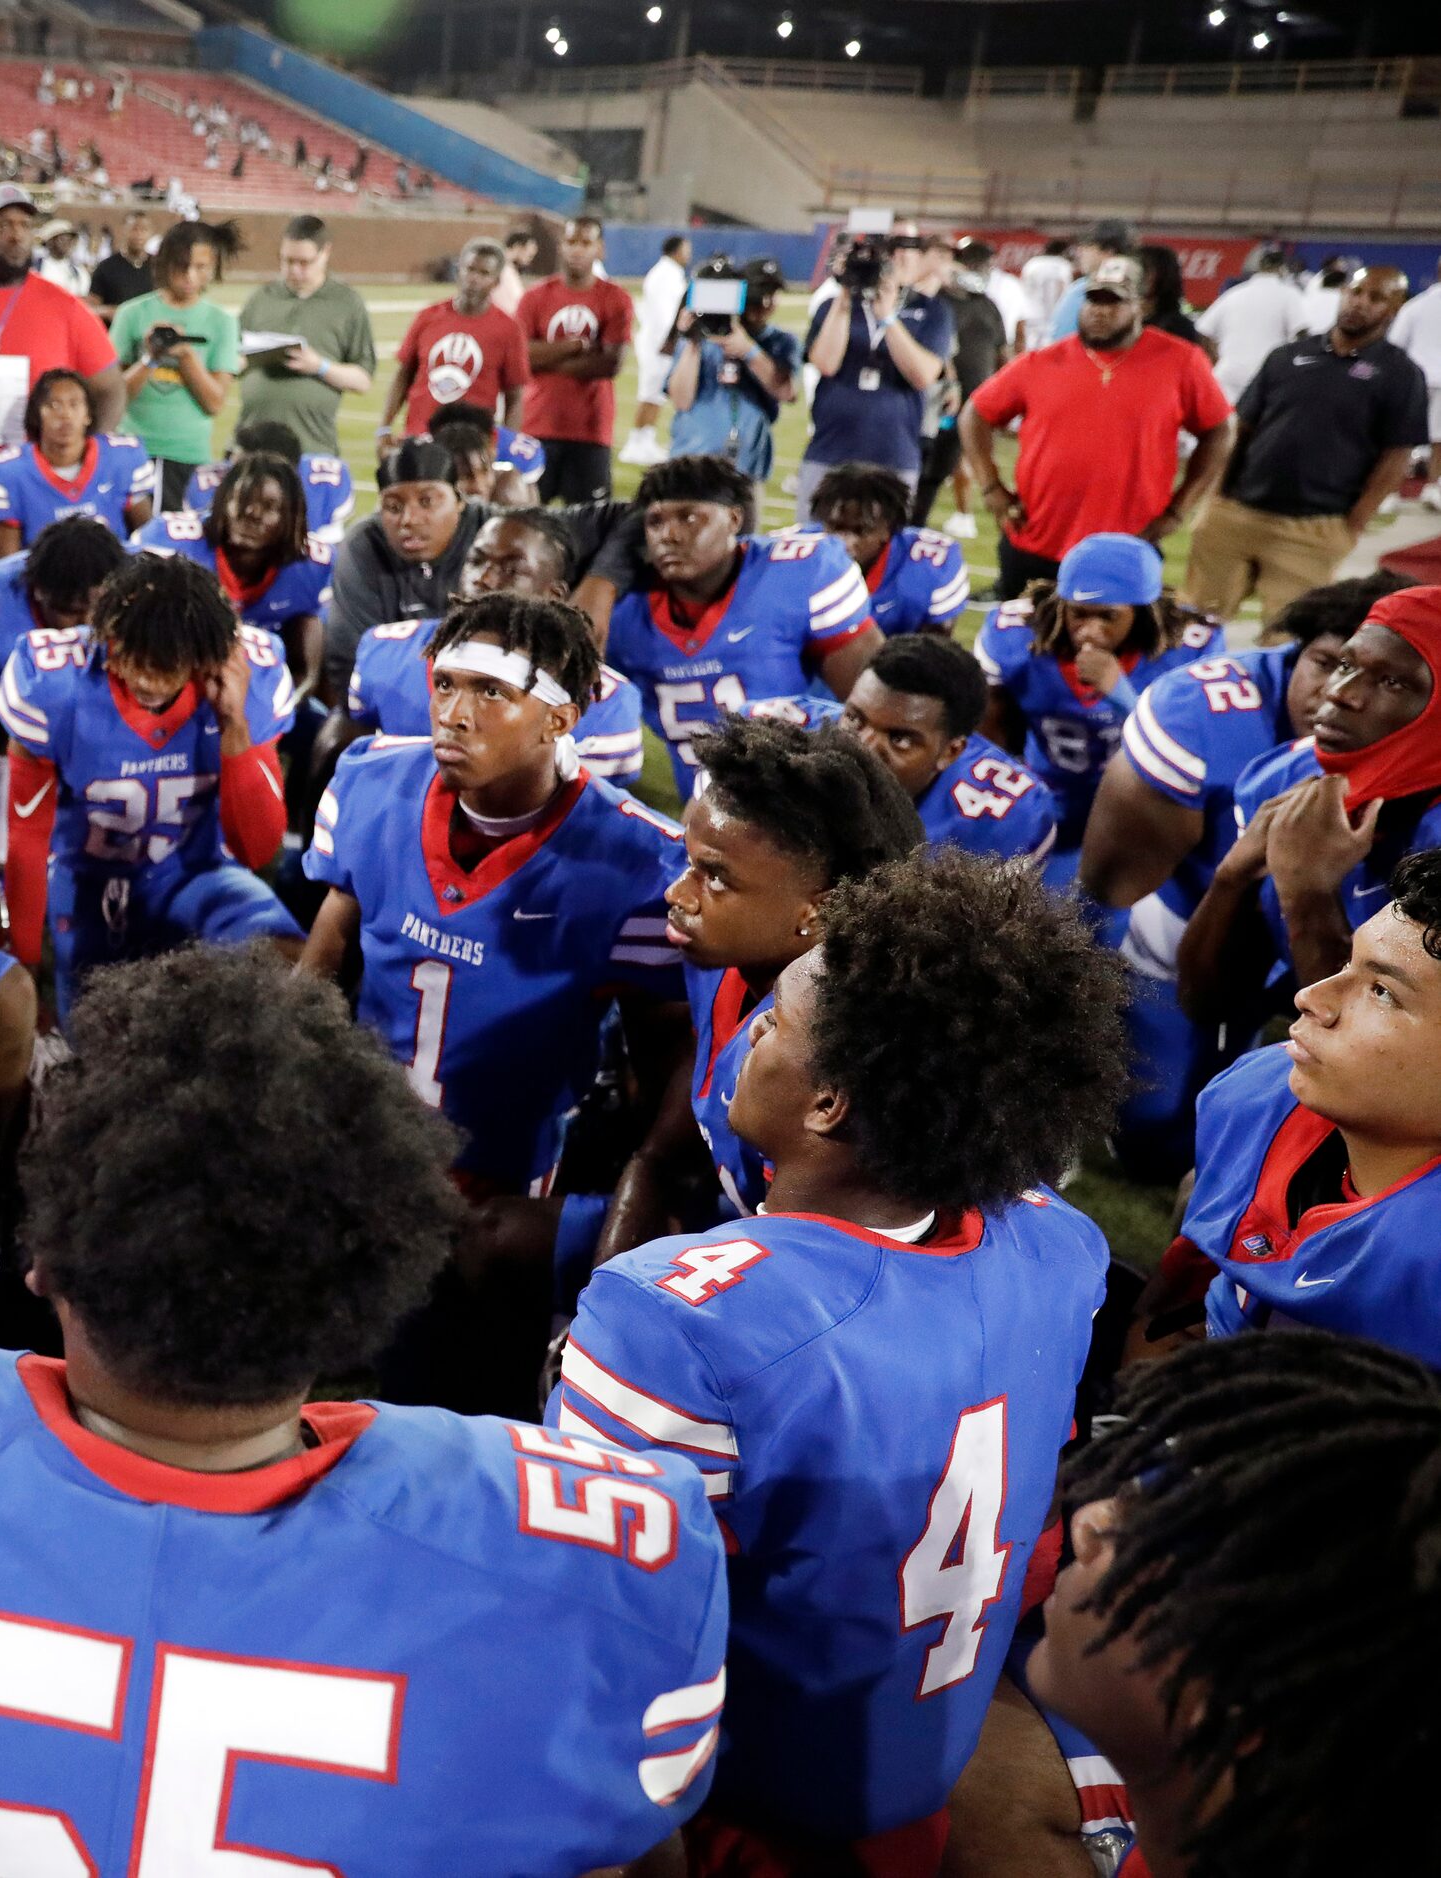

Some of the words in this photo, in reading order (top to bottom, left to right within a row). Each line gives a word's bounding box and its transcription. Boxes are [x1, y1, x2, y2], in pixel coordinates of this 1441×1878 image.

[161, 510, 203, 541] 8
[767, 523, 828, 563] 5
[27, 627, 88, 672] 25
[1186, 656, 1263, 715] 52
[949, 756, 1038, 820] 42
[86, 775, 219, 866] 25
[399, 910, 486, 966] PANTHERS
[405, 958, 453, 1109] 1
[656, 1237, 772, 1307] 4
[502, 1423, 680, 1575] 55
[896, 1393, 1013, 1702] 4
